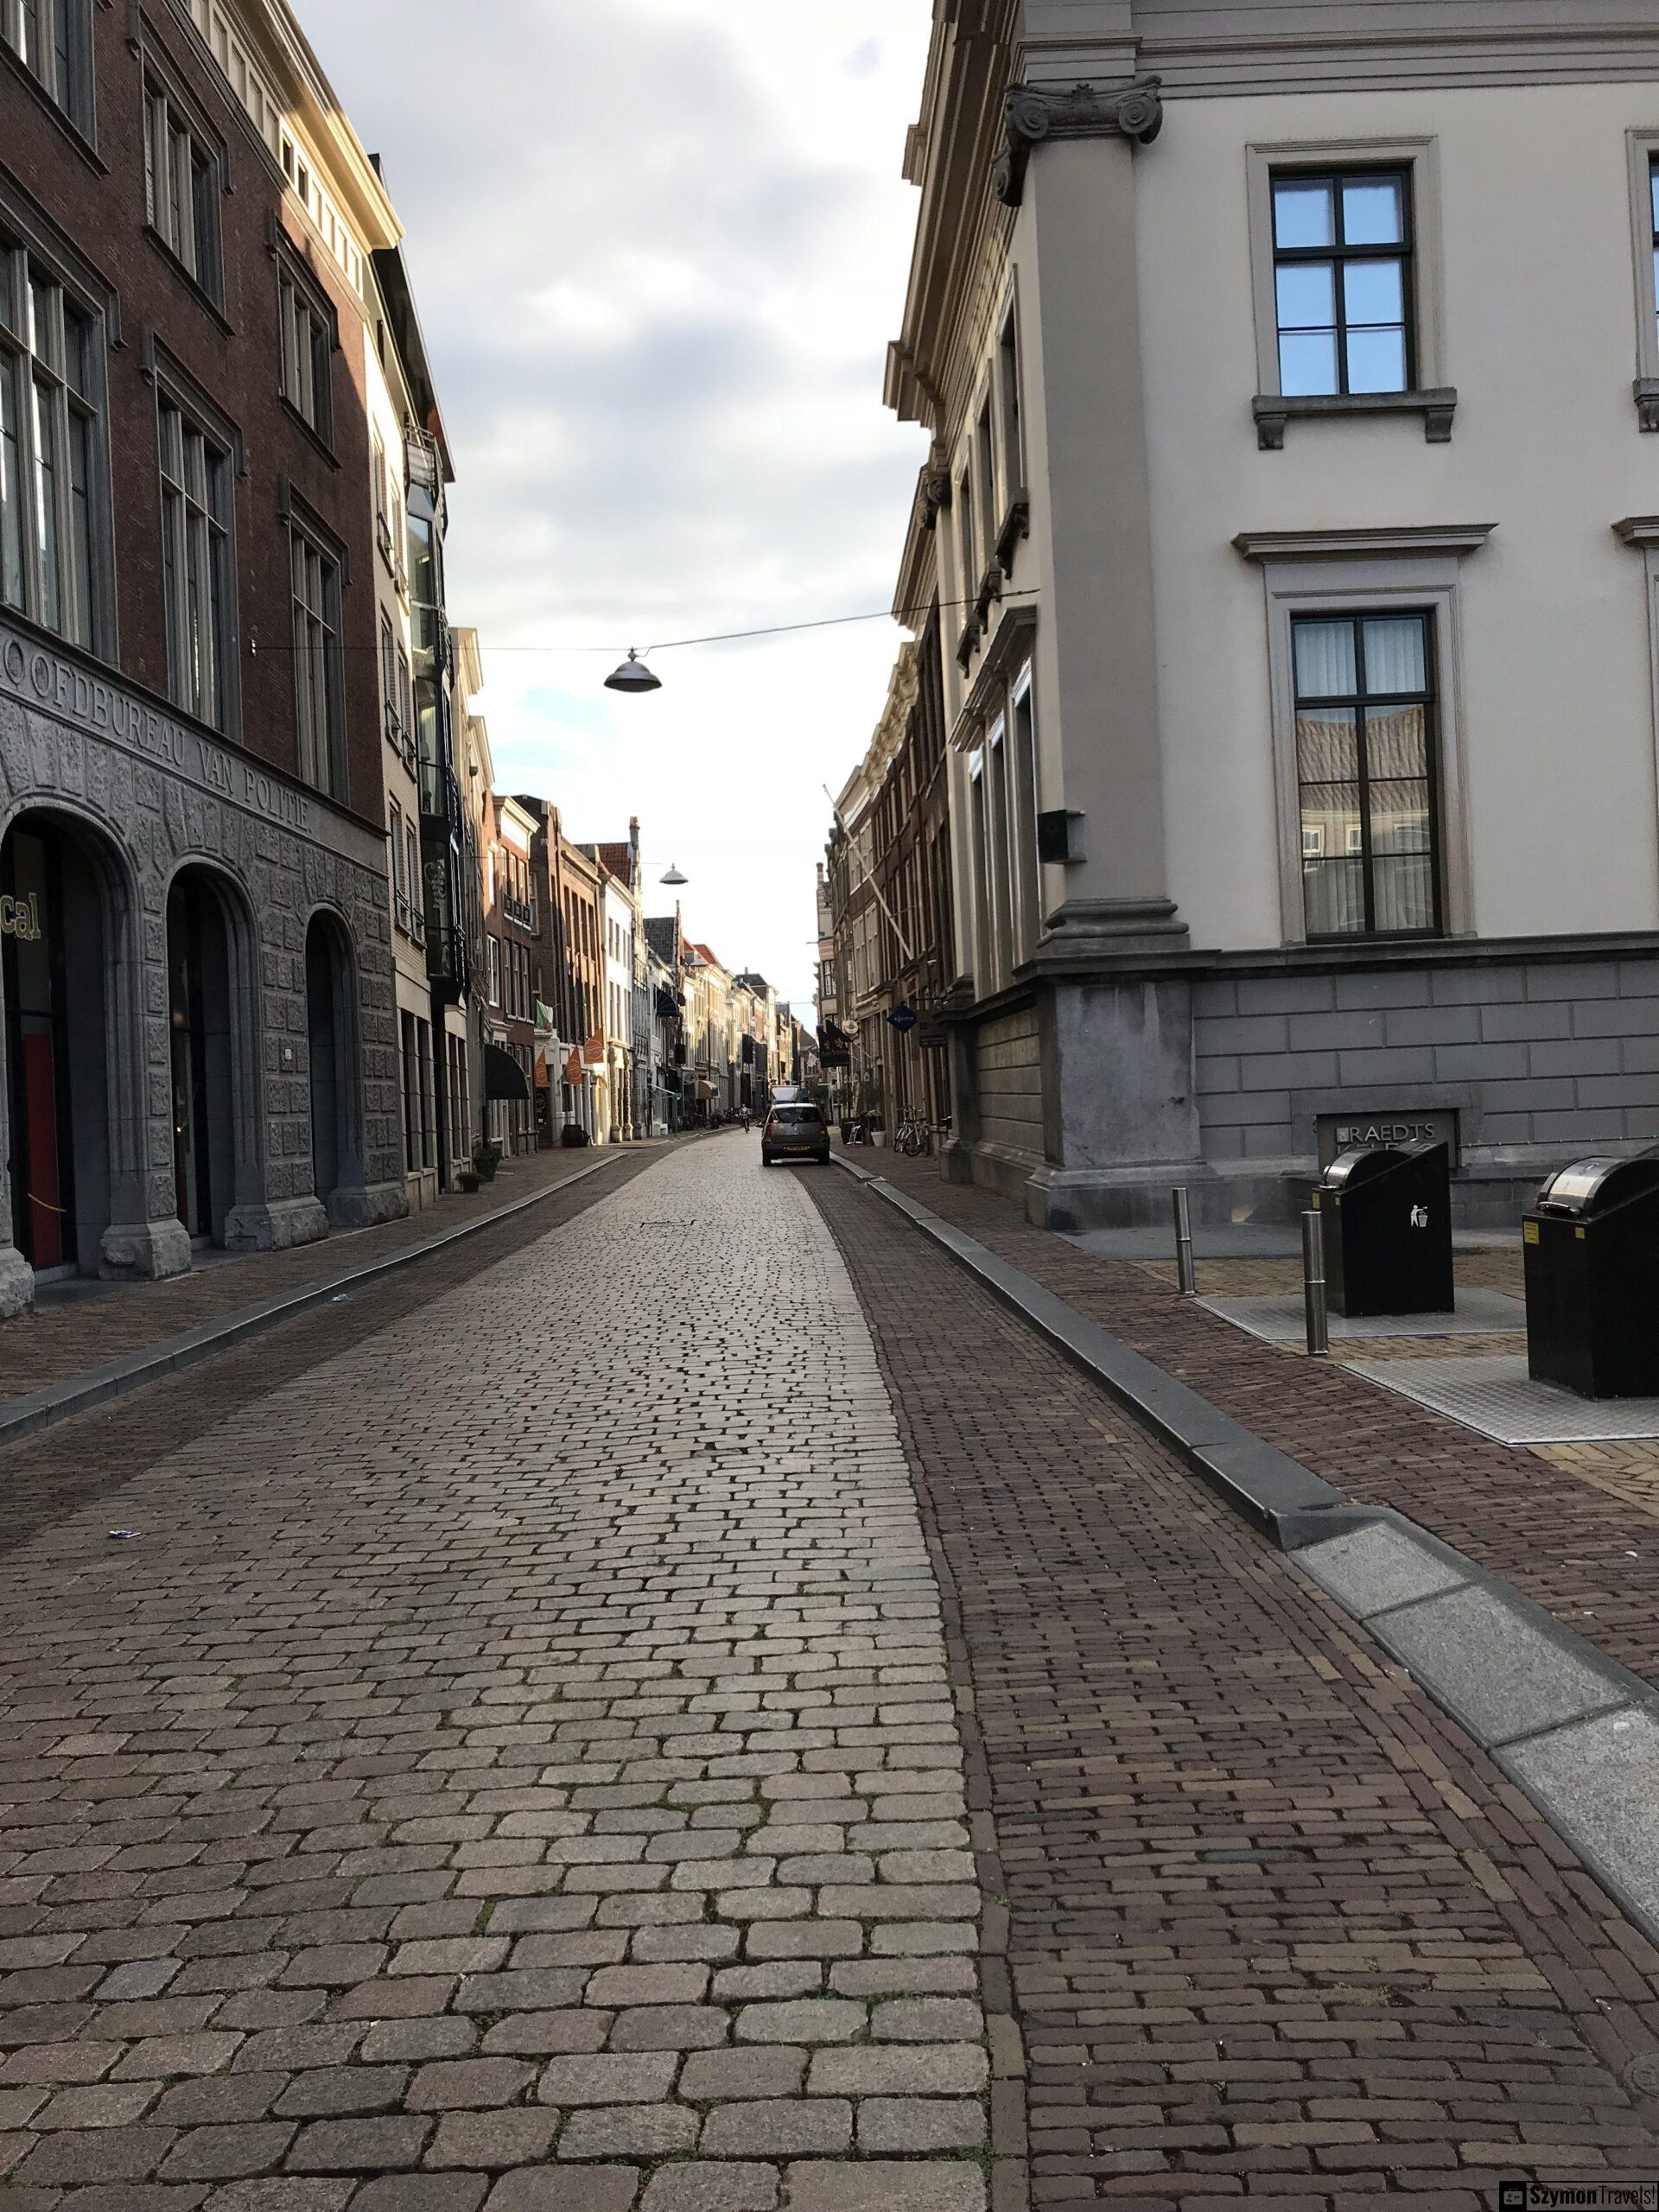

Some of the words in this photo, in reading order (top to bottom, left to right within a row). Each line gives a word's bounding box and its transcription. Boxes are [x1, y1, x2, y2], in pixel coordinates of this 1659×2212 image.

[0, 639, 187, 767] OOFDBUREAU
[196, 741, 234, 794] VAN
[1350, 1123, 1435, 1141] RAEDTS
